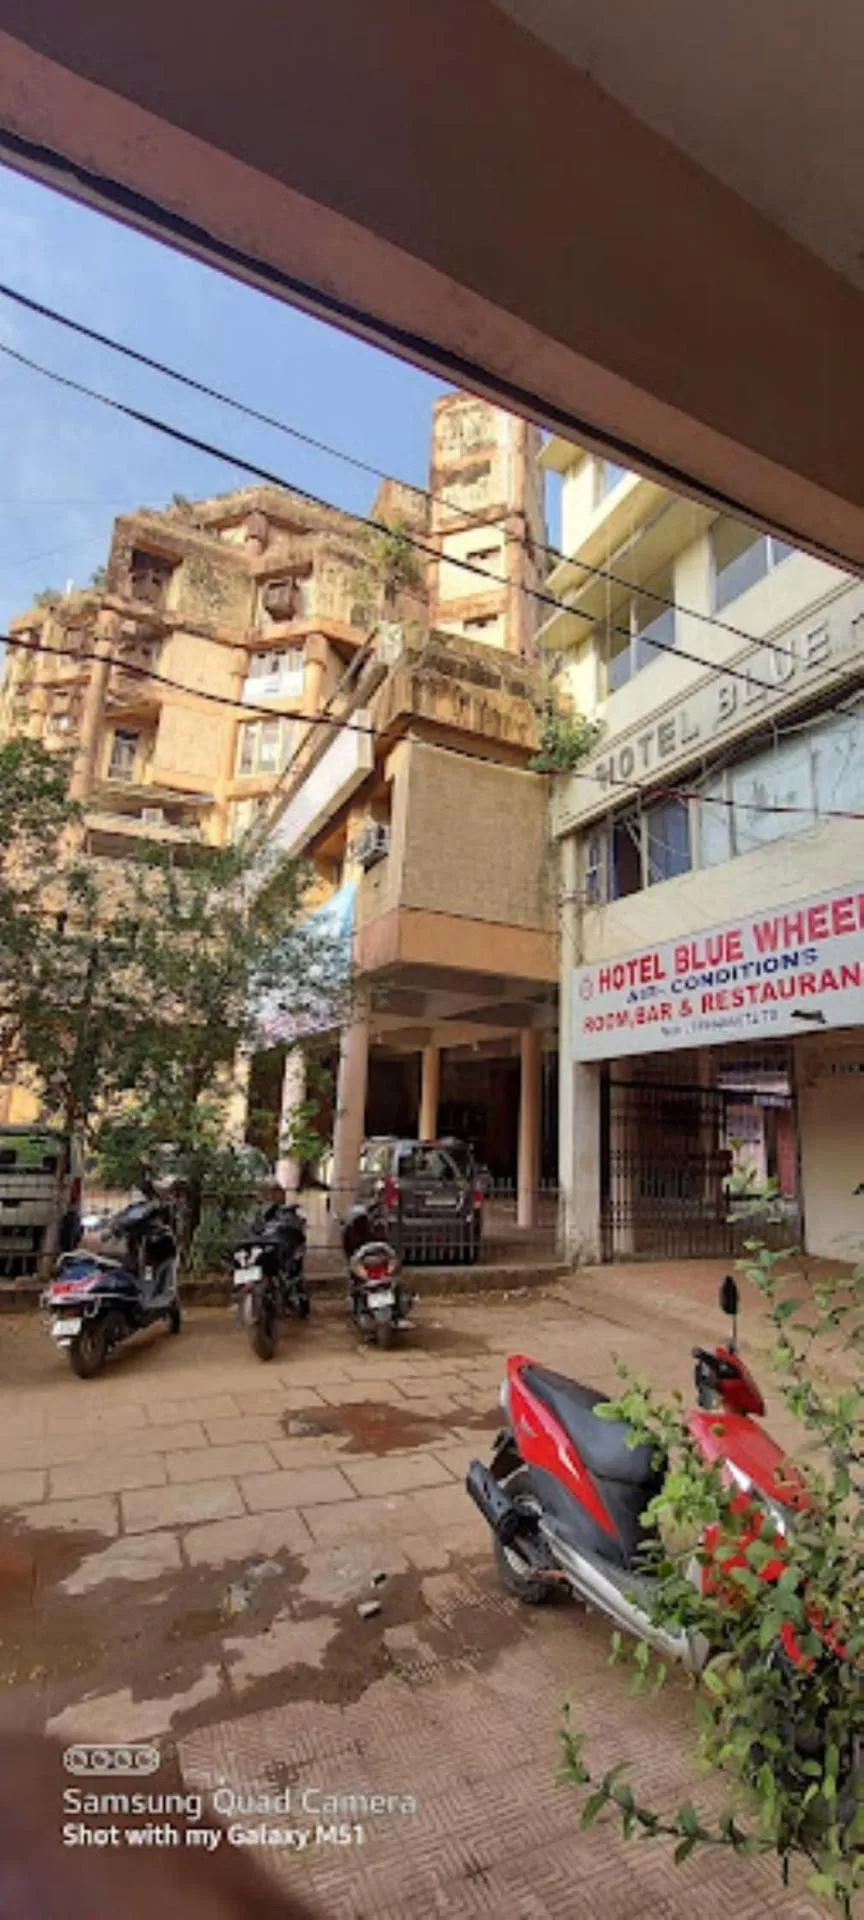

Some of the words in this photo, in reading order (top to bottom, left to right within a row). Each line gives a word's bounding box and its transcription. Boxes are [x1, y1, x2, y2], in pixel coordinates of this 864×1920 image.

[595, 710, 700, 791] HOTEL
[714, 620, 831, 730] BLUE
[598, 953, 666, 993] HOTEL
[674, 928, 745, 975] BLUE
[670, 947, 820, 994] CONDITIONS
